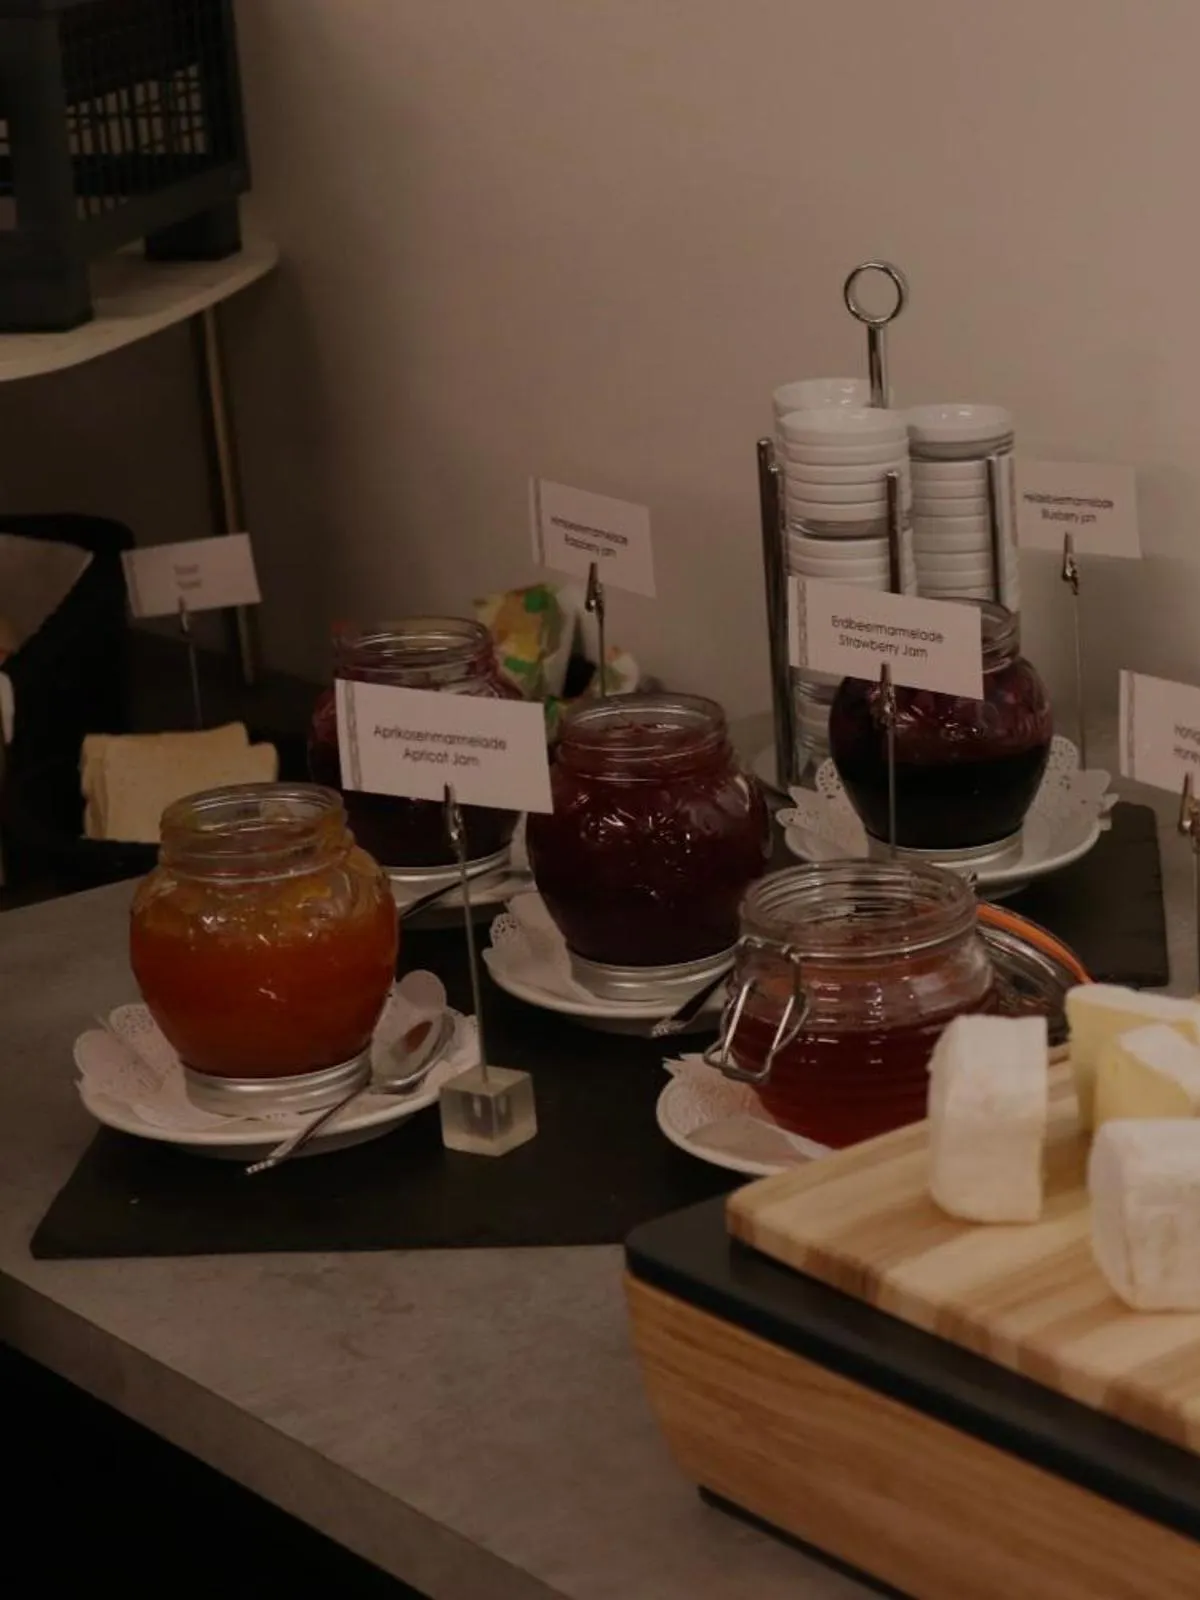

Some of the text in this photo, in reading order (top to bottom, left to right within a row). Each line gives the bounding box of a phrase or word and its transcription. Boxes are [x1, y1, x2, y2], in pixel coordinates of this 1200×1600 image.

[831, 615, 945, 644] Erdbeermarmelade
[838, 633, 929, 660] Strawberry Jam
[373, 725, 508, 752] Aprikosenmarmelade
[402, 747, 480, 767] Apricot Jam
